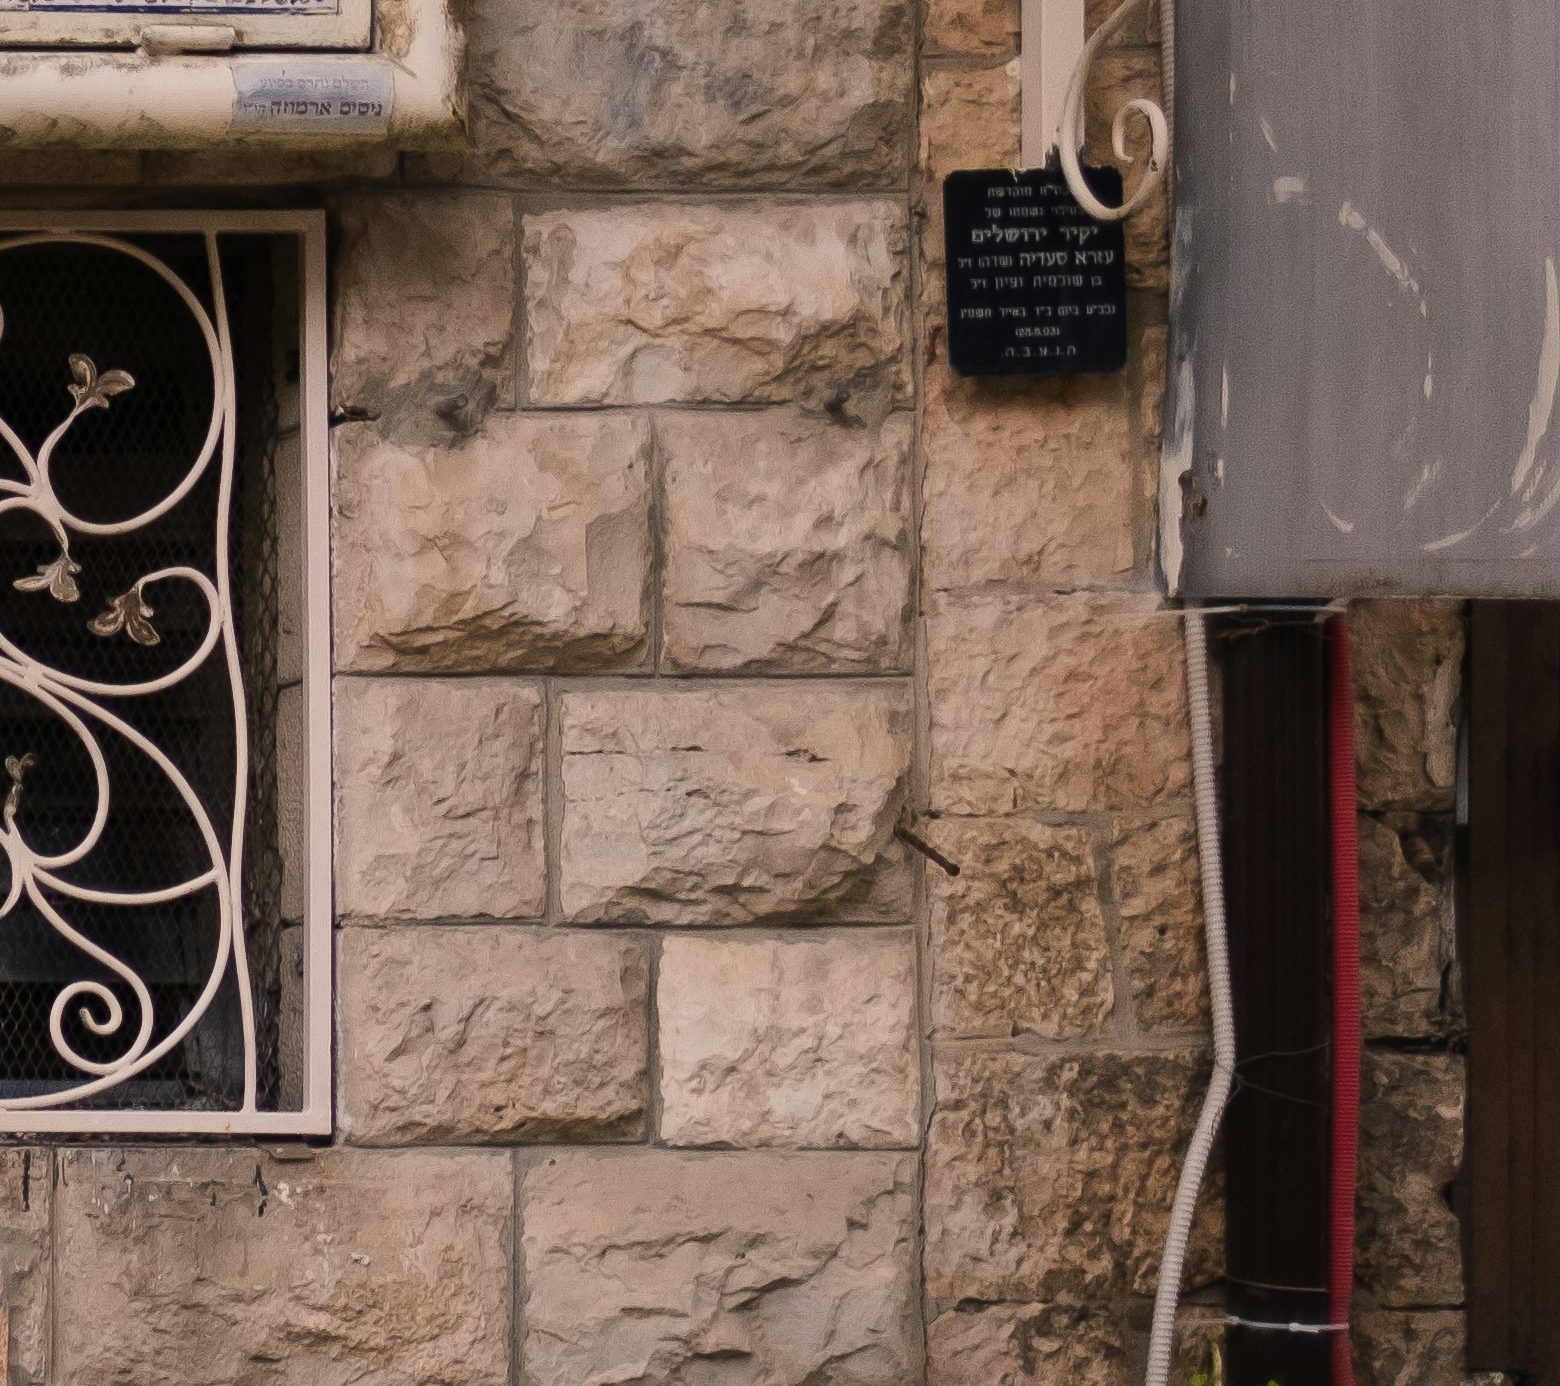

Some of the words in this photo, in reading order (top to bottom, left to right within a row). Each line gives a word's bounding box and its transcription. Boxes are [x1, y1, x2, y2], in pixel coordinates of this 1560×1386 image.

[971, 223, 1048, 243] ירושלים
[1059, 225, 1098, 245] יקיר
[1020, 251, 1068, 267] סעדיה
[1075, 250, 1114, 266] עזרא
